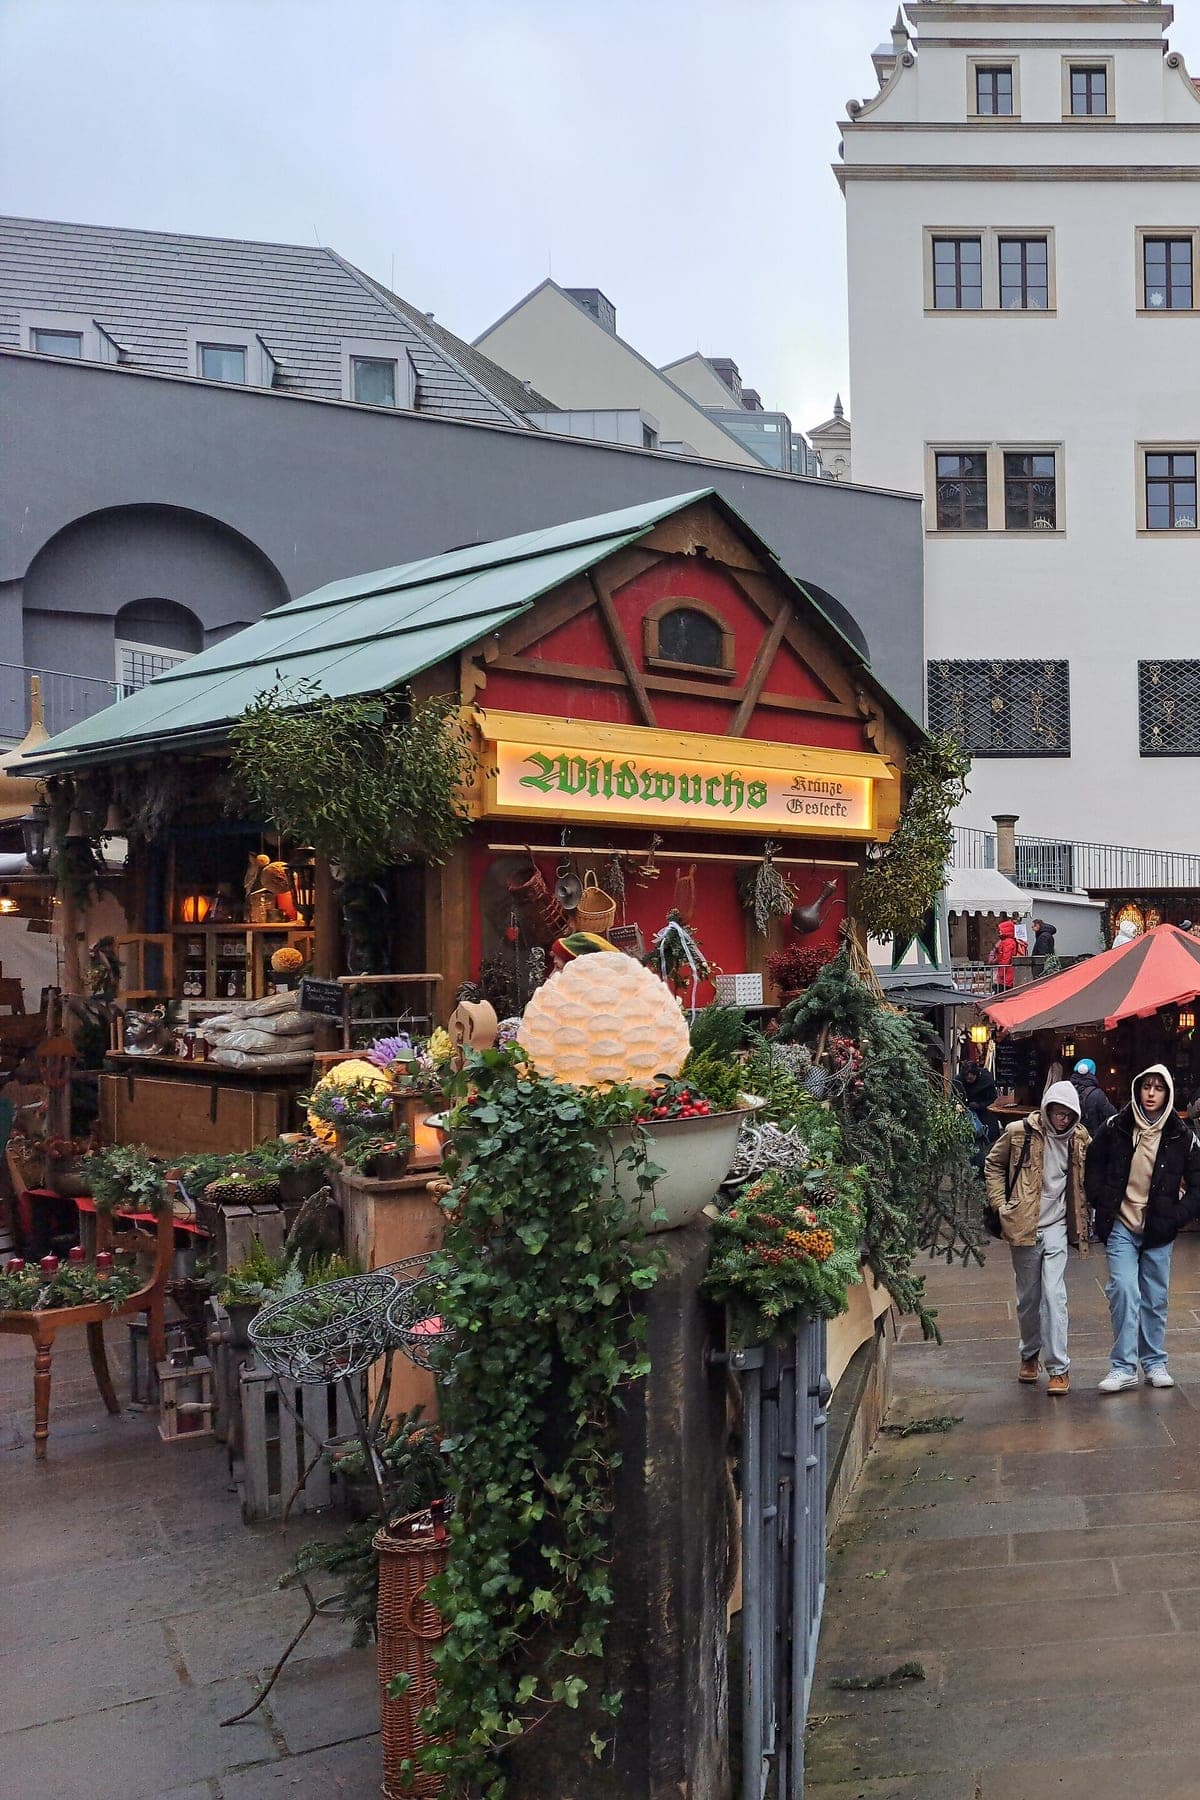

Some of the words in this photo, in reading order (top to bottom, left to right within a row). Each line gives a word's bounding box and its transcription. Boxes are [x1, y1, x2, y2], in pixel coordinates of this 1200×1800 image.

[519, 751, 768, 814] Wildwuchs
[791, 775, 843, 796] Kränze
[785, 799, 849, 818] Gestecke
